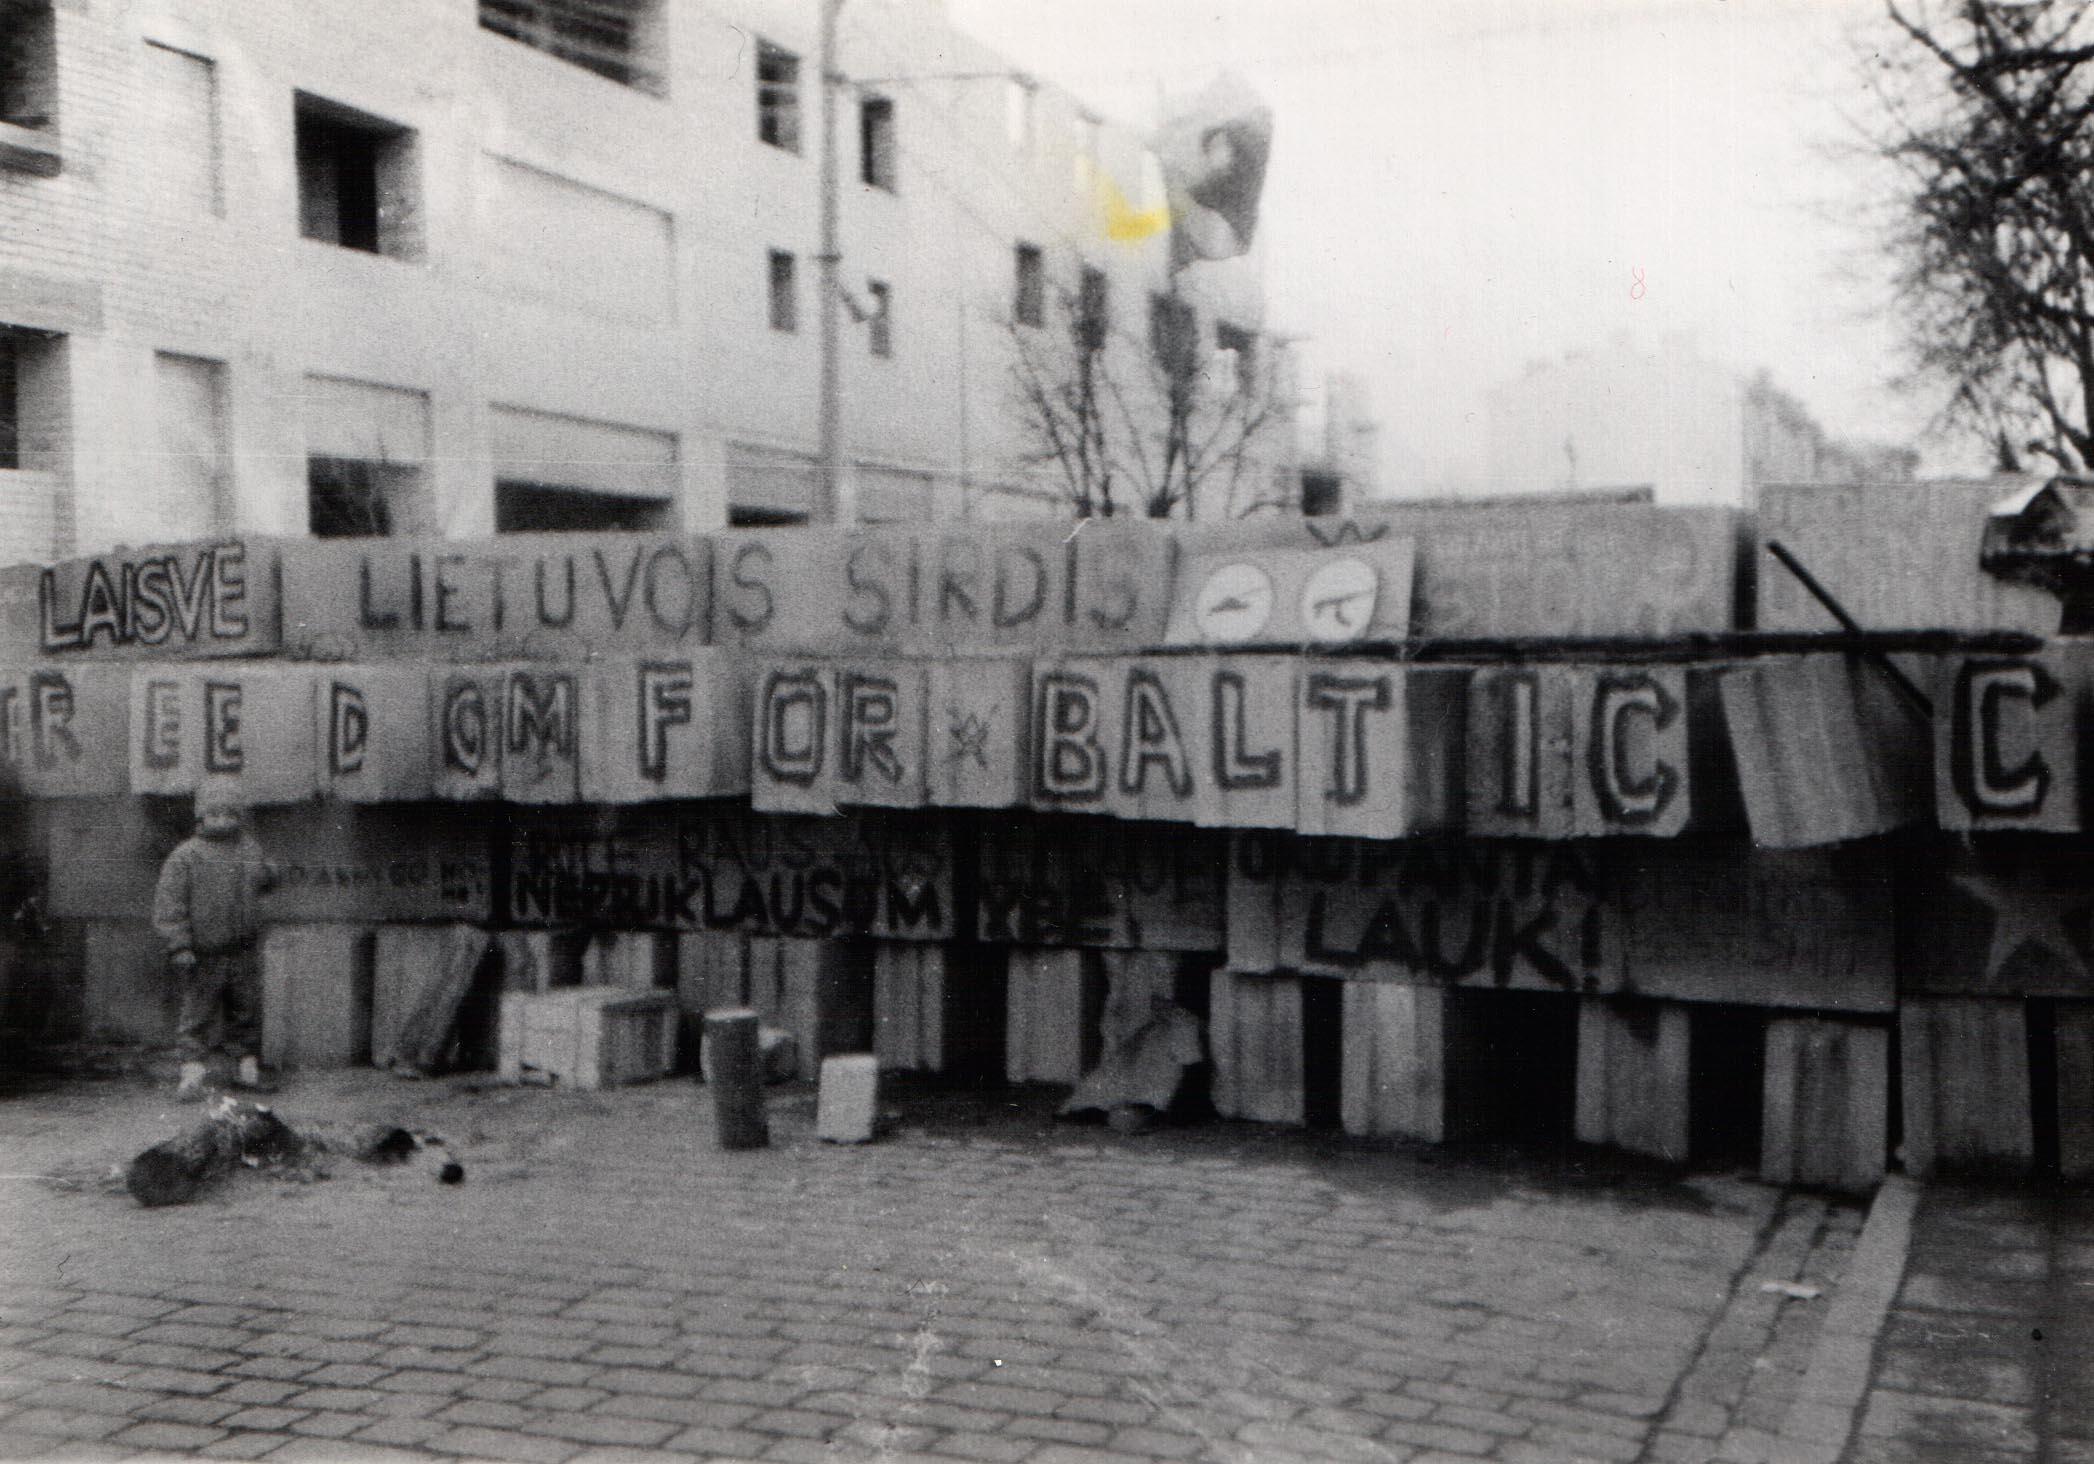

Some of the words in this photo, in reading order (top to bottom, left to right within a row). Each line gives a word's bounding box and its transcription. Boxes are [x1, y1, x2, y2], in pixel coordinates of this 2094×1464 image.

[636, 660, 902, 786] FOR
[1036, 667, 1680, 827] BALTIC
[1949, 658, 2060, 818] C
